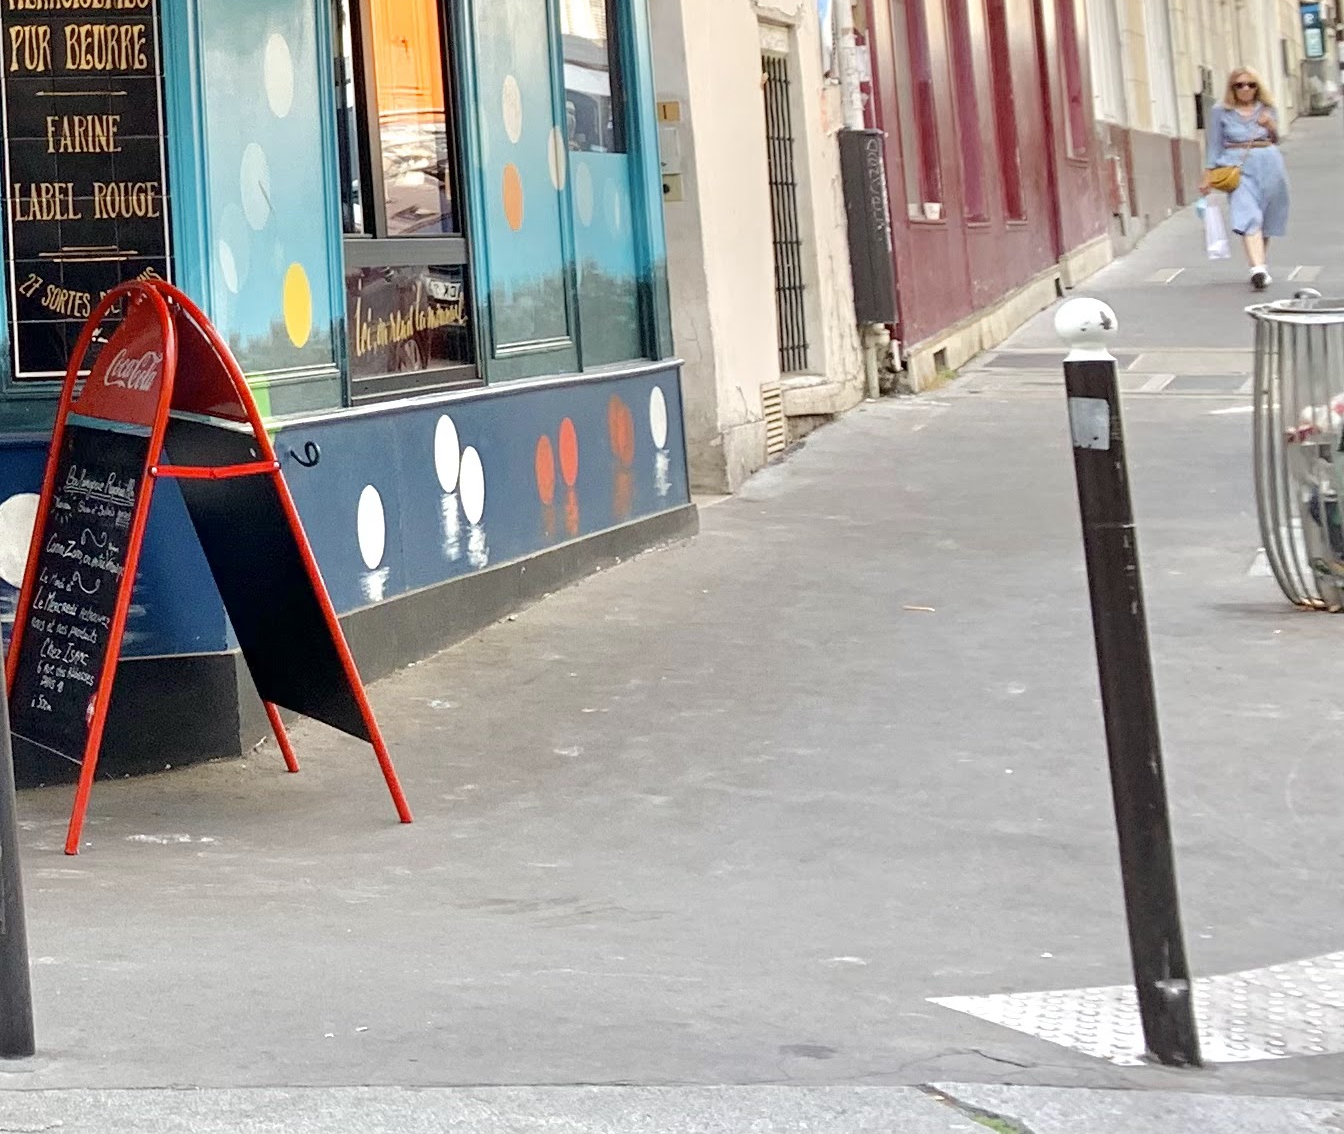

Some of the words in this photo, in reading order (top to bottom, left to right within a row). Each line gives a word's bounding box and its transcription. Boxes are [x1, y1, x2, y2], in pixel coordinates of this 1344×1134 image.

[9, 24, 52, 72] PUR
[64, 24, 148, 71] BEURRE
[45, 114, 122, 154] FARINE
[13, 182, 82, 222] LABEL
[92, 181, 160, 218] ROUGE
[19, 273, 43, 298] 27
[41, 284, 91, 318] SORTES
